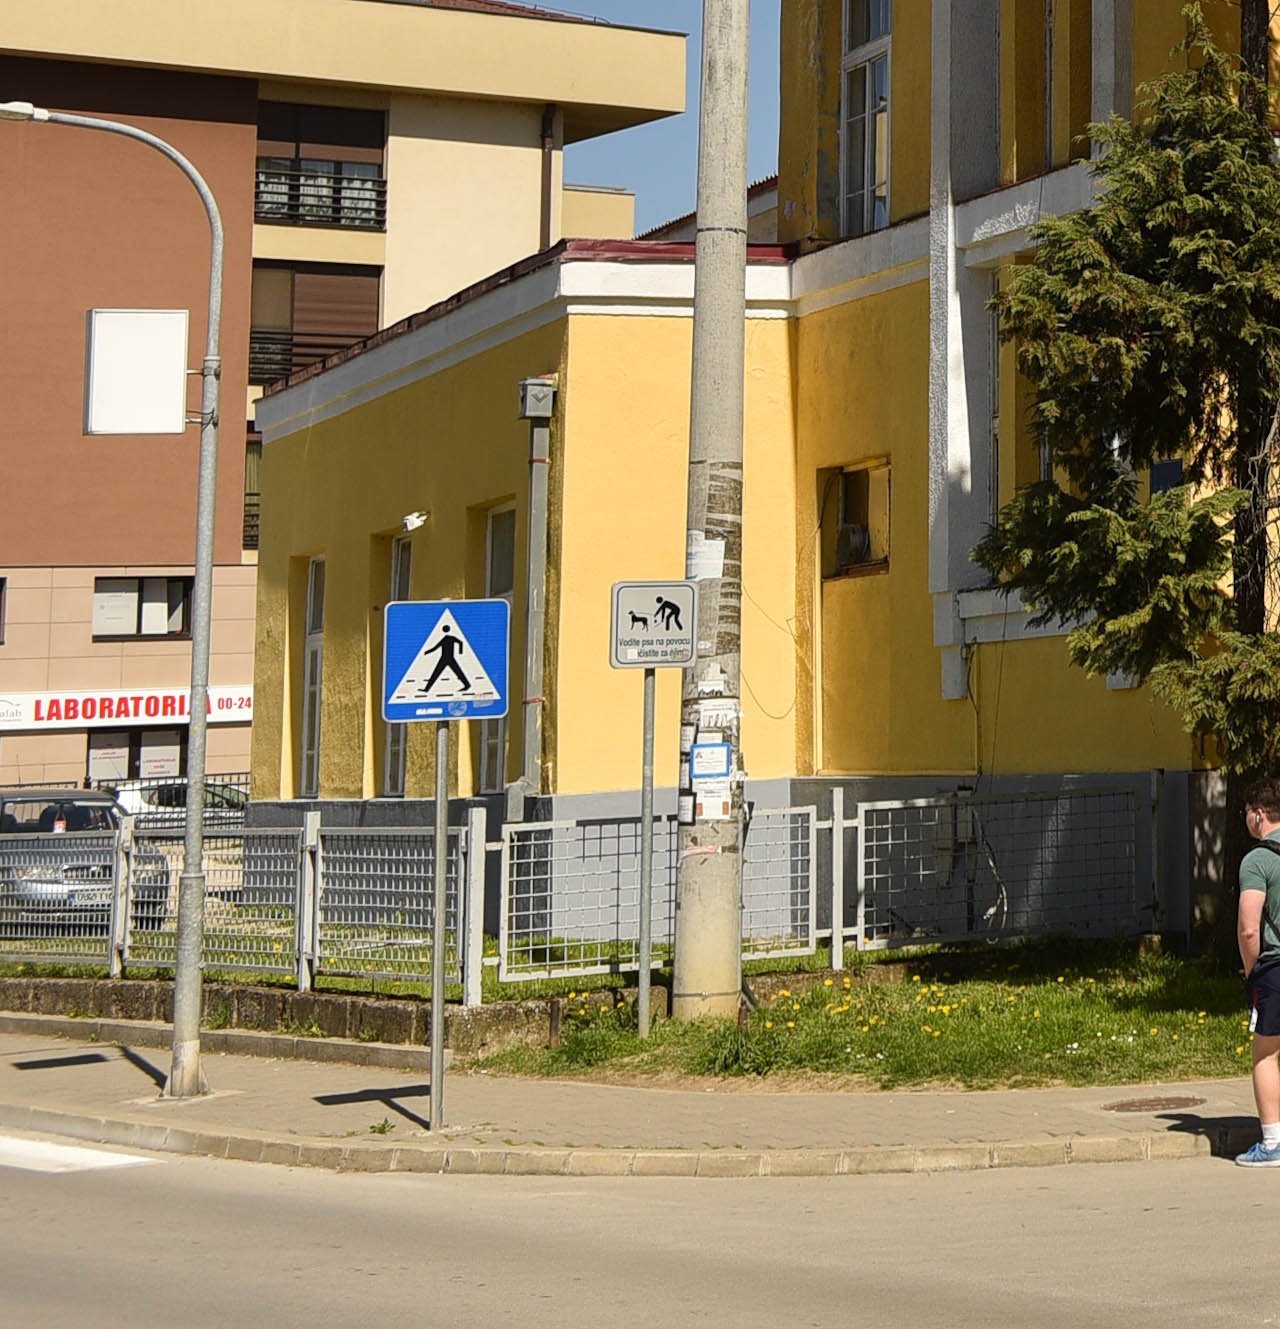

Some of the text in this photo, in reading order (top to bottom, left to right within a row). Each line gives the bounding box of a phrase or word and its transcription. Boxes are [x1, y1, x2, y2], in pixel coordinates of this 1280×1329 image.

[619, 637, 640, 646] Vodite
[642, 638, 654, 647] psa
[666, 637, 690, 646] povocu
[217, 697, 252, 709] 00-24
